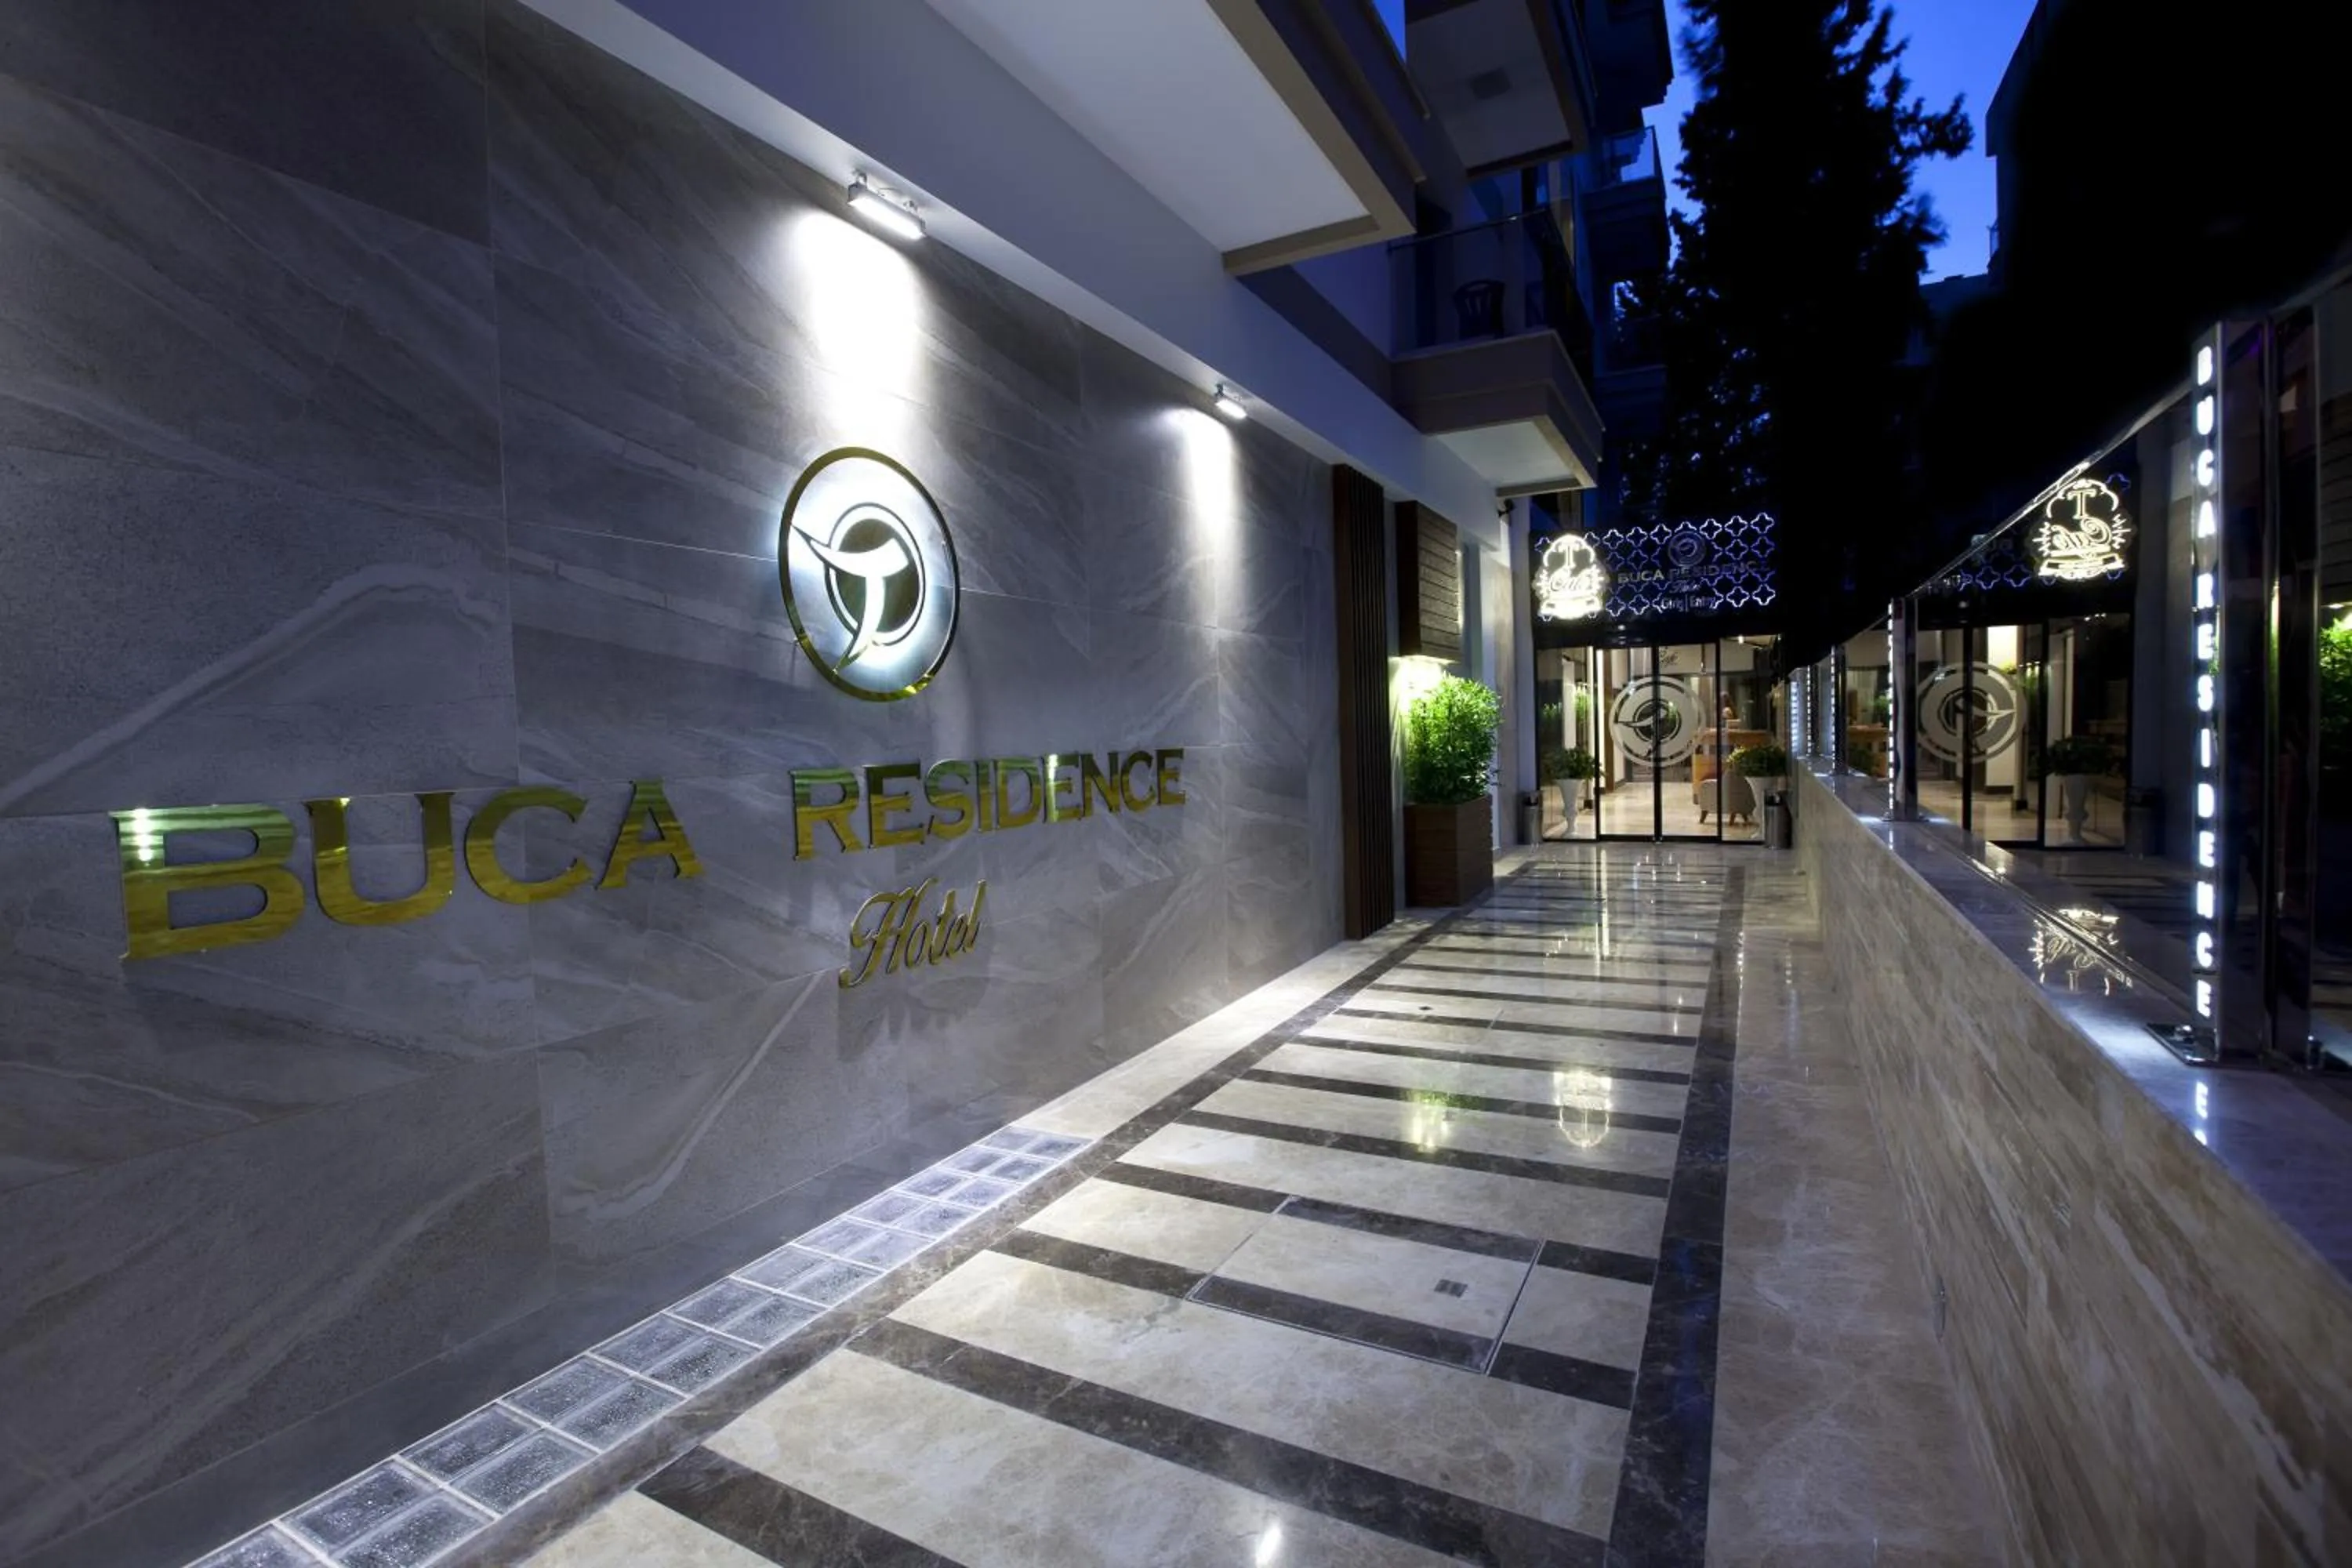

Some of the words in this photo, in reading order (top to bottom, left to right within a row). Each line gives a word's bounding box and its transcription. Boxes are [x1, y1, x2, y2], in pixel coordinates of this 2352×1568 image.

[2198, 346, 2216, 539] BUCA
[1617, 569, 1664, 583] BUCA
[107, 779, 705, 961] BUCA
[788, 747, 1186, 861] RESIDENCE
[2197, 572, 2215, 1018] RESIDENCE
[839, 877, 986, 989] Hotel
